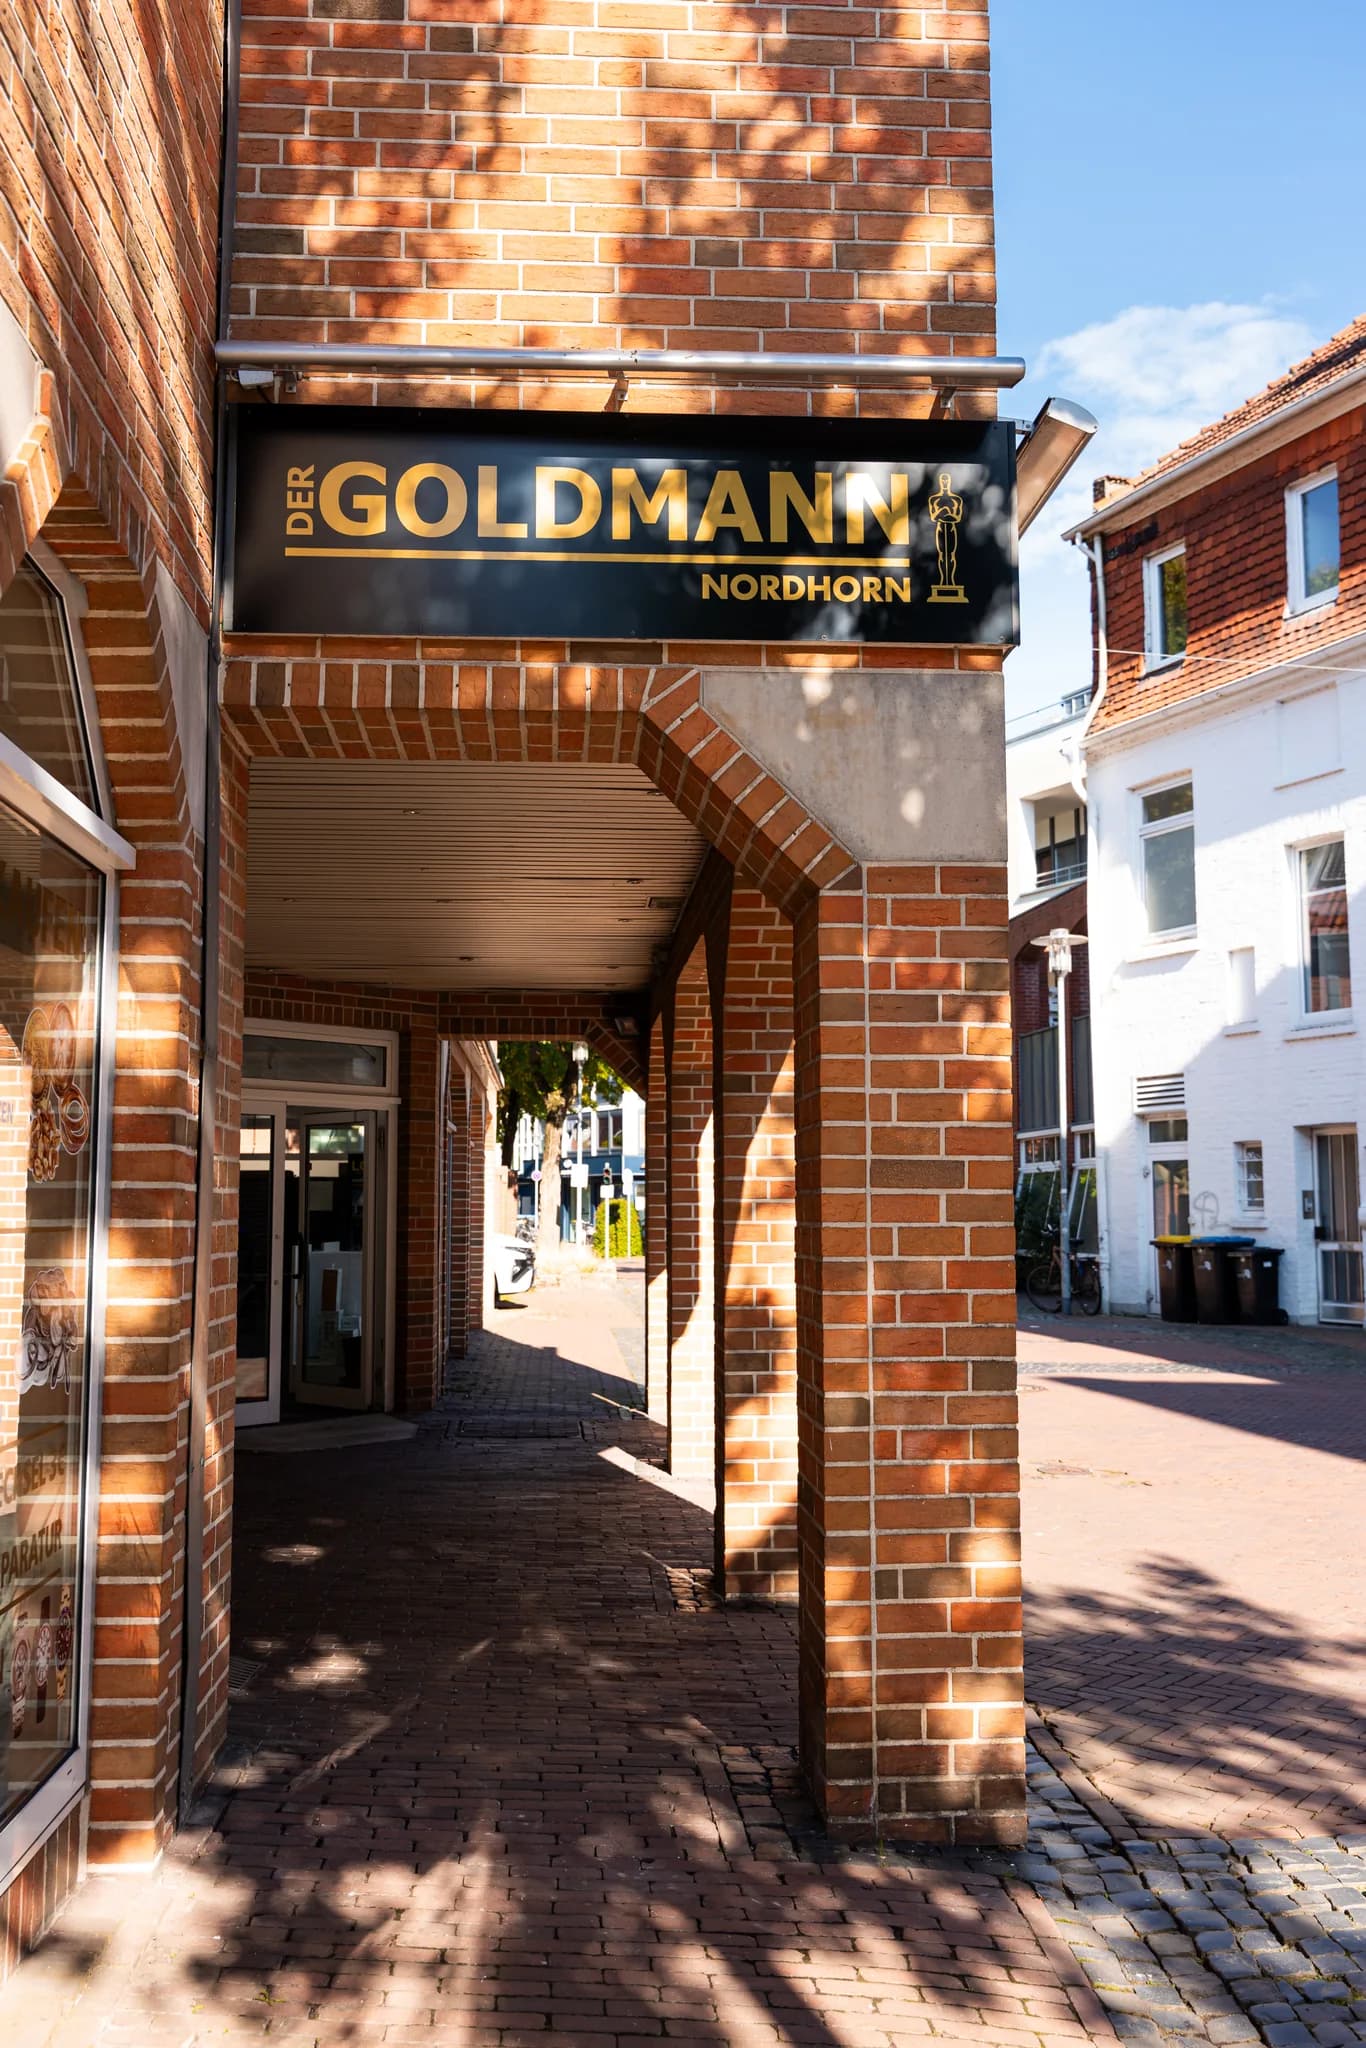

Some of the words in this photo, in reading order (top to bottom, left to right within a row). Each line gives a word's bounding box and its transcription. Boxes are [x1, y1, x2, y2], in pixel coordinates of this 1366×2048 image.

[286, 464, 315, 535] DER
[319, 461, 910, 545] GOLDMANN
[702, 573, 911, 603] NORDHORN
[1, 1517, 62, 1588] PARATUR
